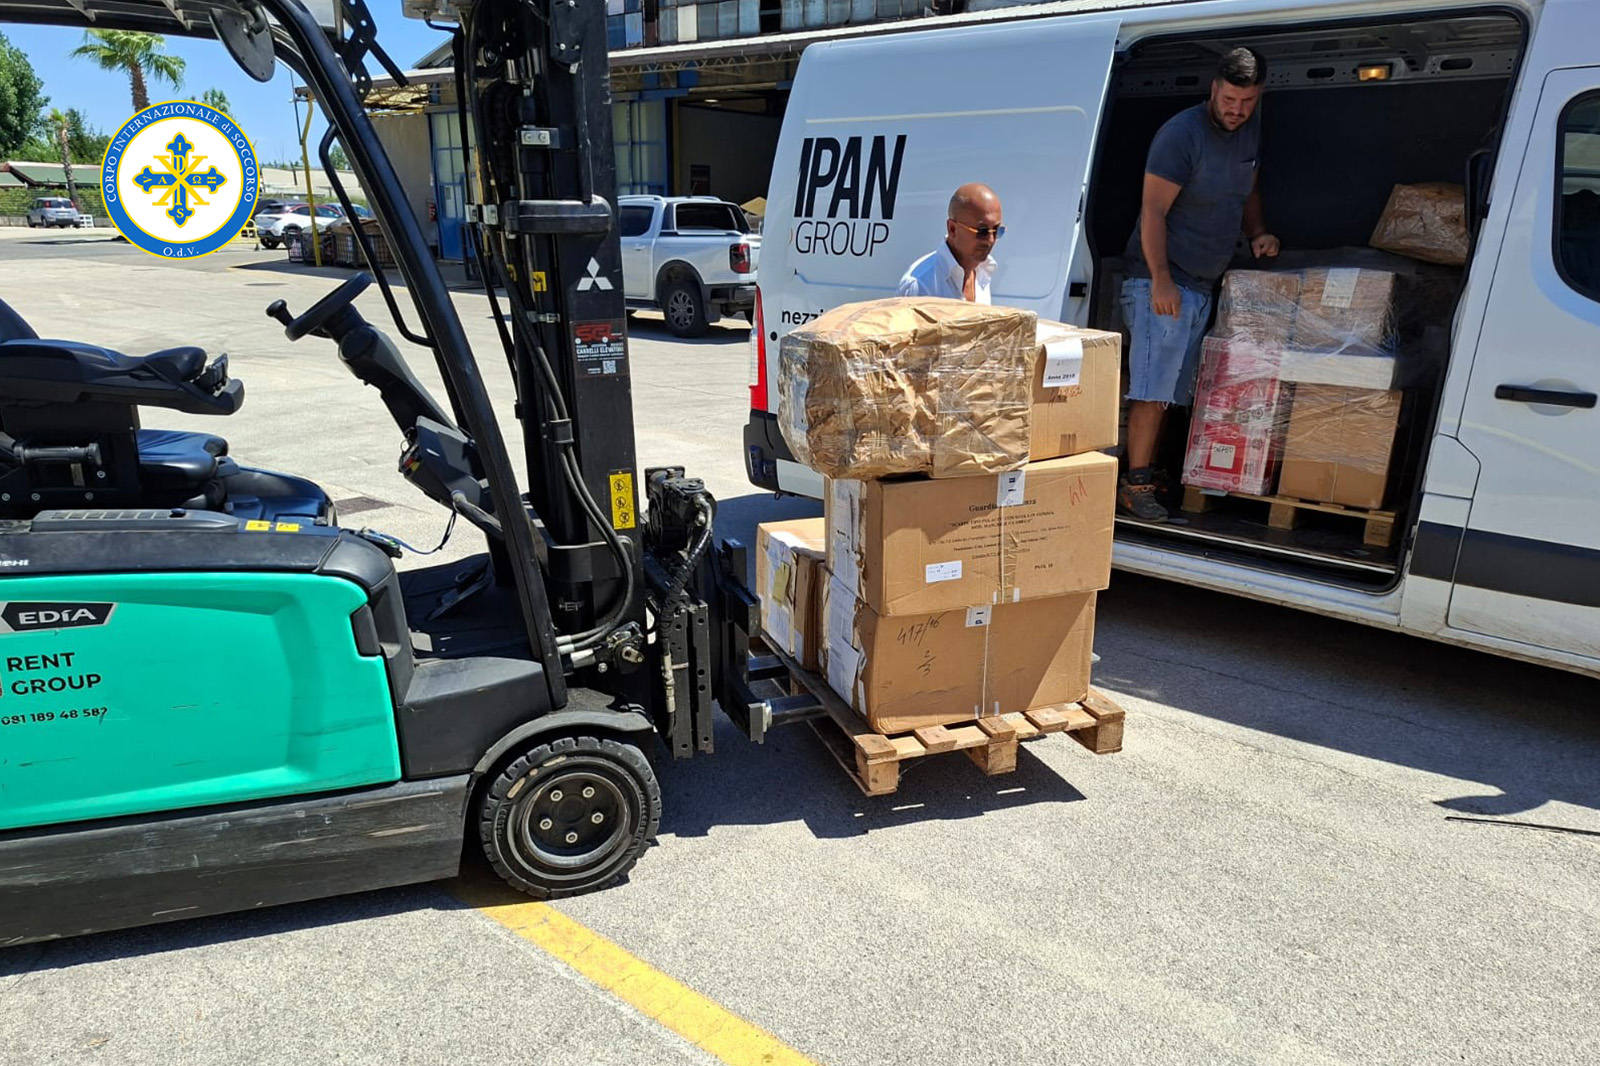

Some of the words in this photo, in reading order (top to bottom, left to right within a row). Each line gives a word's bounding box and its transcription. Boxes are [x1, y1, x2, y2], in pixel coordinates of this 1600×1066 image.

[793, 134, 908, 220] IPAN
[795, 220, 890, 257] GROUP
[781, 308, 824, 325] nezz
[6, 652, 76, 672] RENT
[11, 673, 102, 696] GROUP
[30, 712, 55, 722] 189
[60, 709, 78, 719] 48
